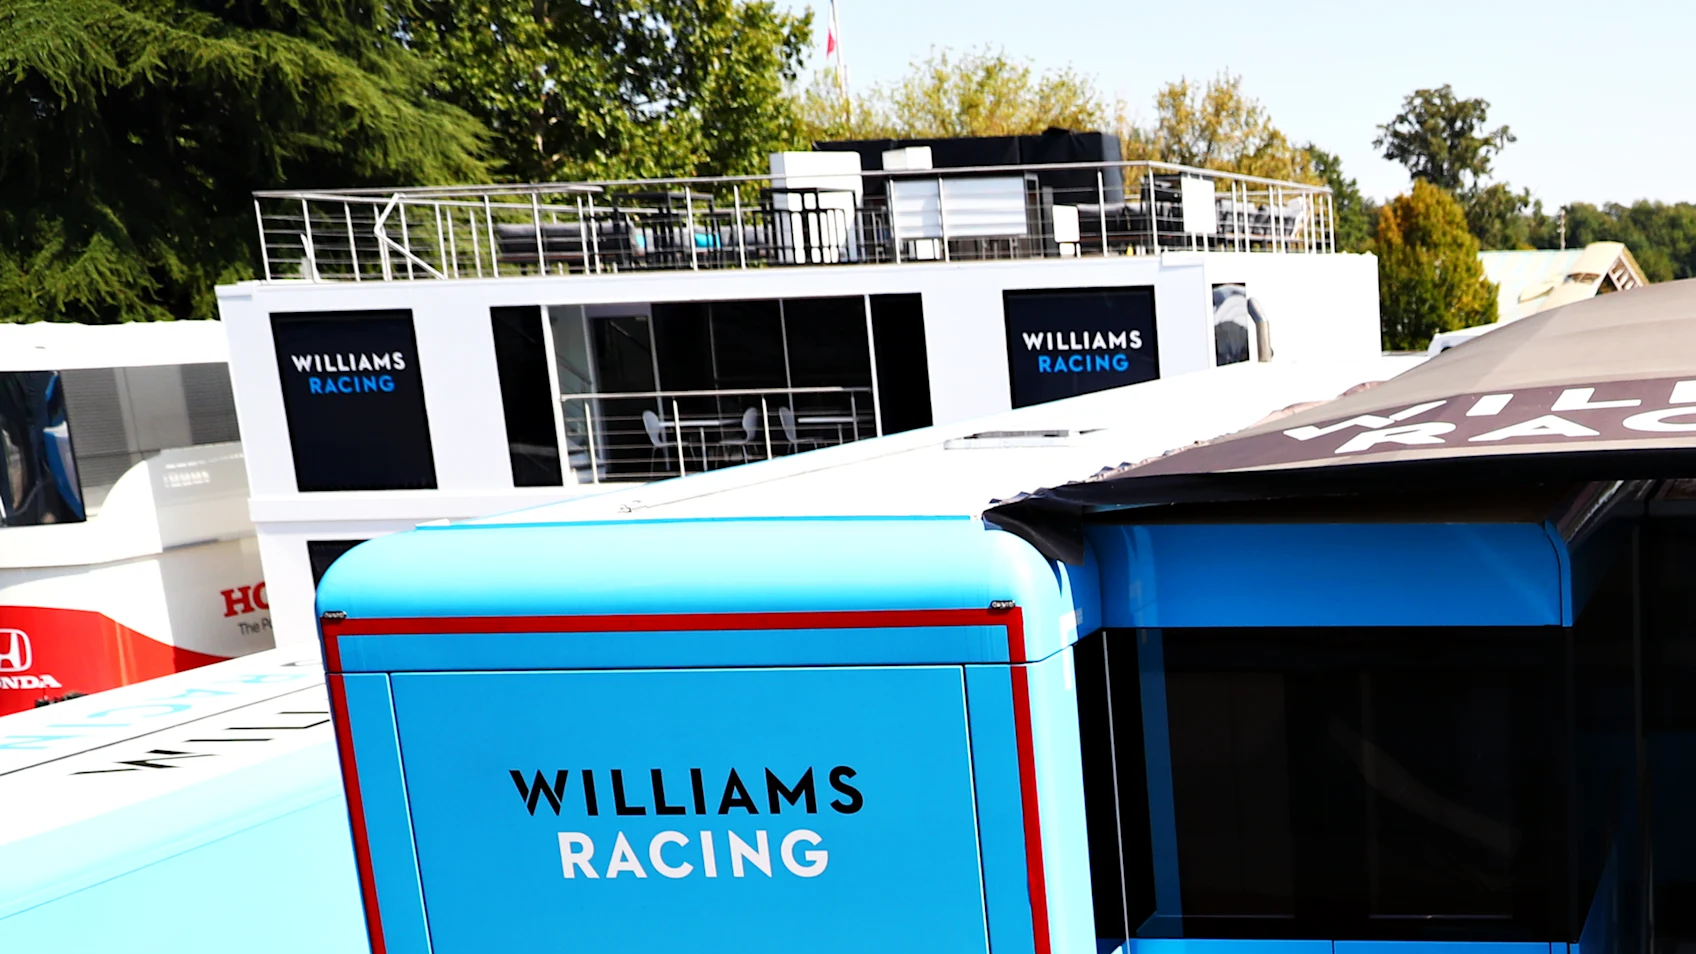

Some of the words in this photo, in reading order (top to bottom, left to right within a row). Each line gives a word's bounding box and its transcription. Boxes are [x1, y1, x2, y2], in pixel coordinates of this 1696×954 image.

[1022, 330, 1143, 351] WILLIAMS
[291, 351, 406, 373] WILLIAMS
[1038, 353, 1130, 373] RACING
[308, 373, 396, 395] RACING
[0, 673, 63, 690] NDA
[509, 765, 864, 816] WILLIAMS
[557, 829, 829, 879] RACING
